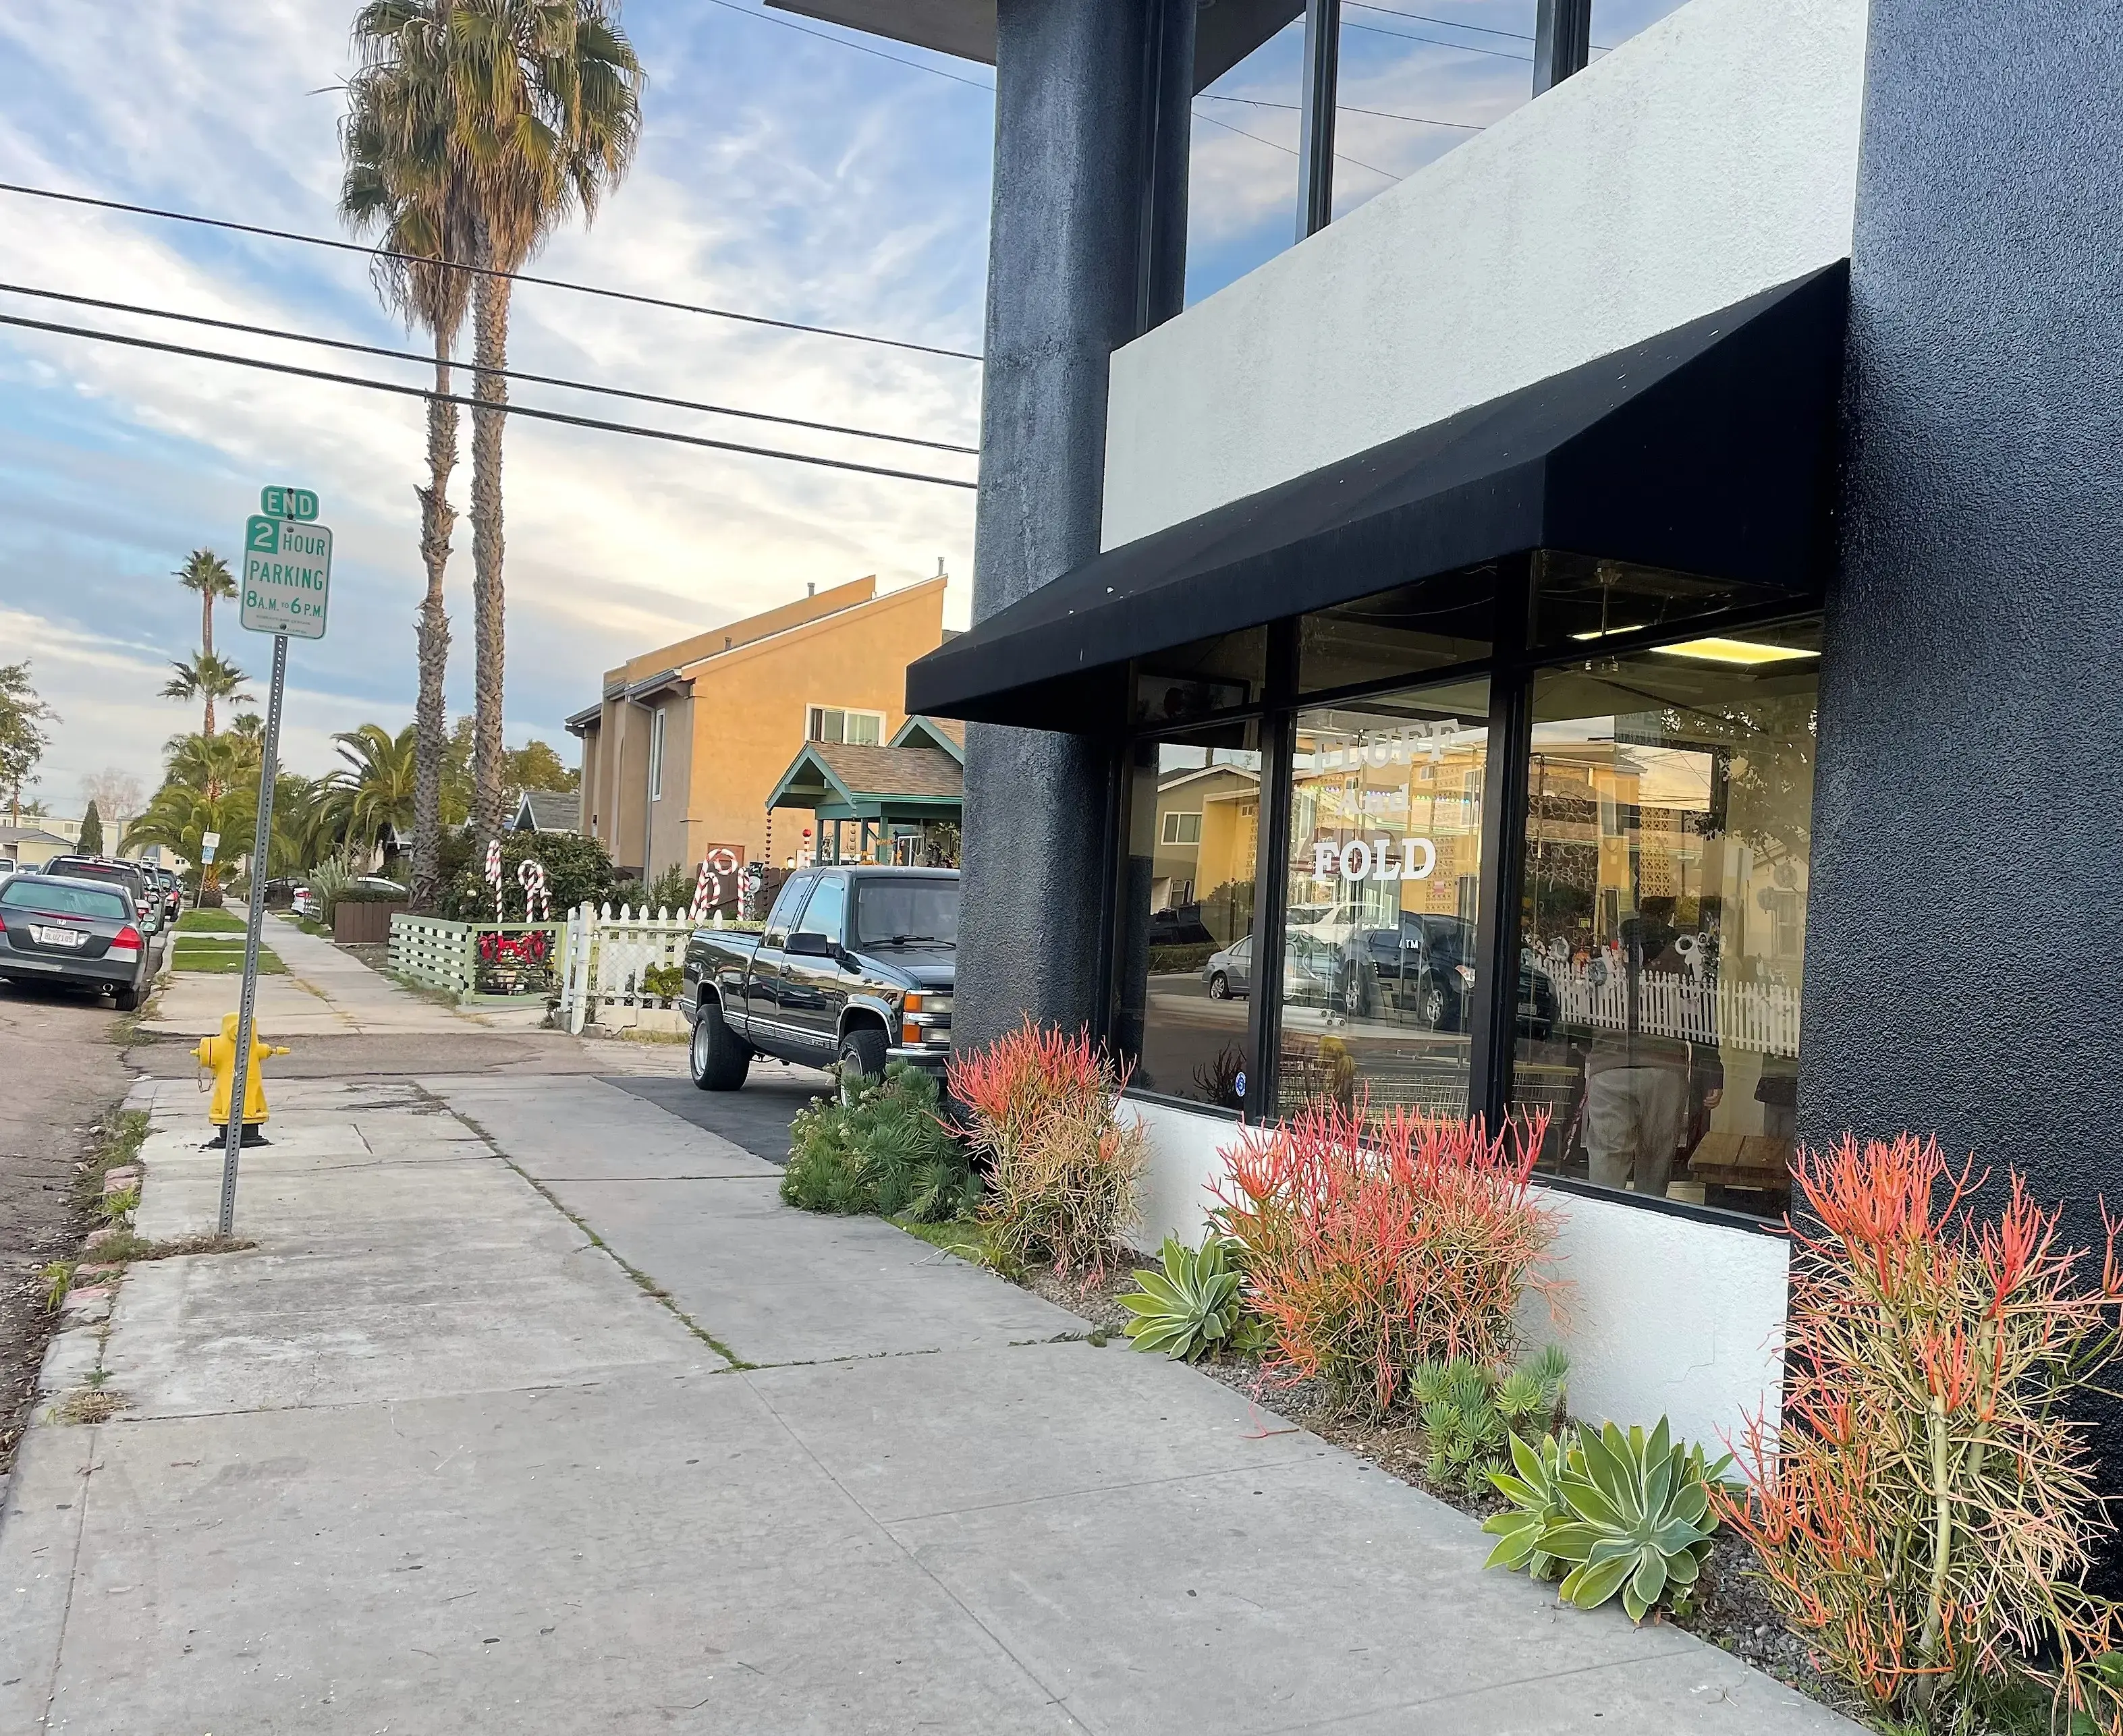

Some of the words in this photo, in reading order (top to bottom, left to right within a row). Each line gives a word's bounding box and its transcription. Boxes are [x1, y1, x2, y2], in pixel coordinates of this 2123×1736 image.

[267, 491, 313, 516] END
[253, 522, 273, 548] 2
[283, 533, 325, 556] HOUR
[249, 560, 324, 591] PARKING
[1311, 719, 1460, 775] FLUFF
[1335, 783, 1411, 815] And
[1312, 837, 1436, 881] FOLD
